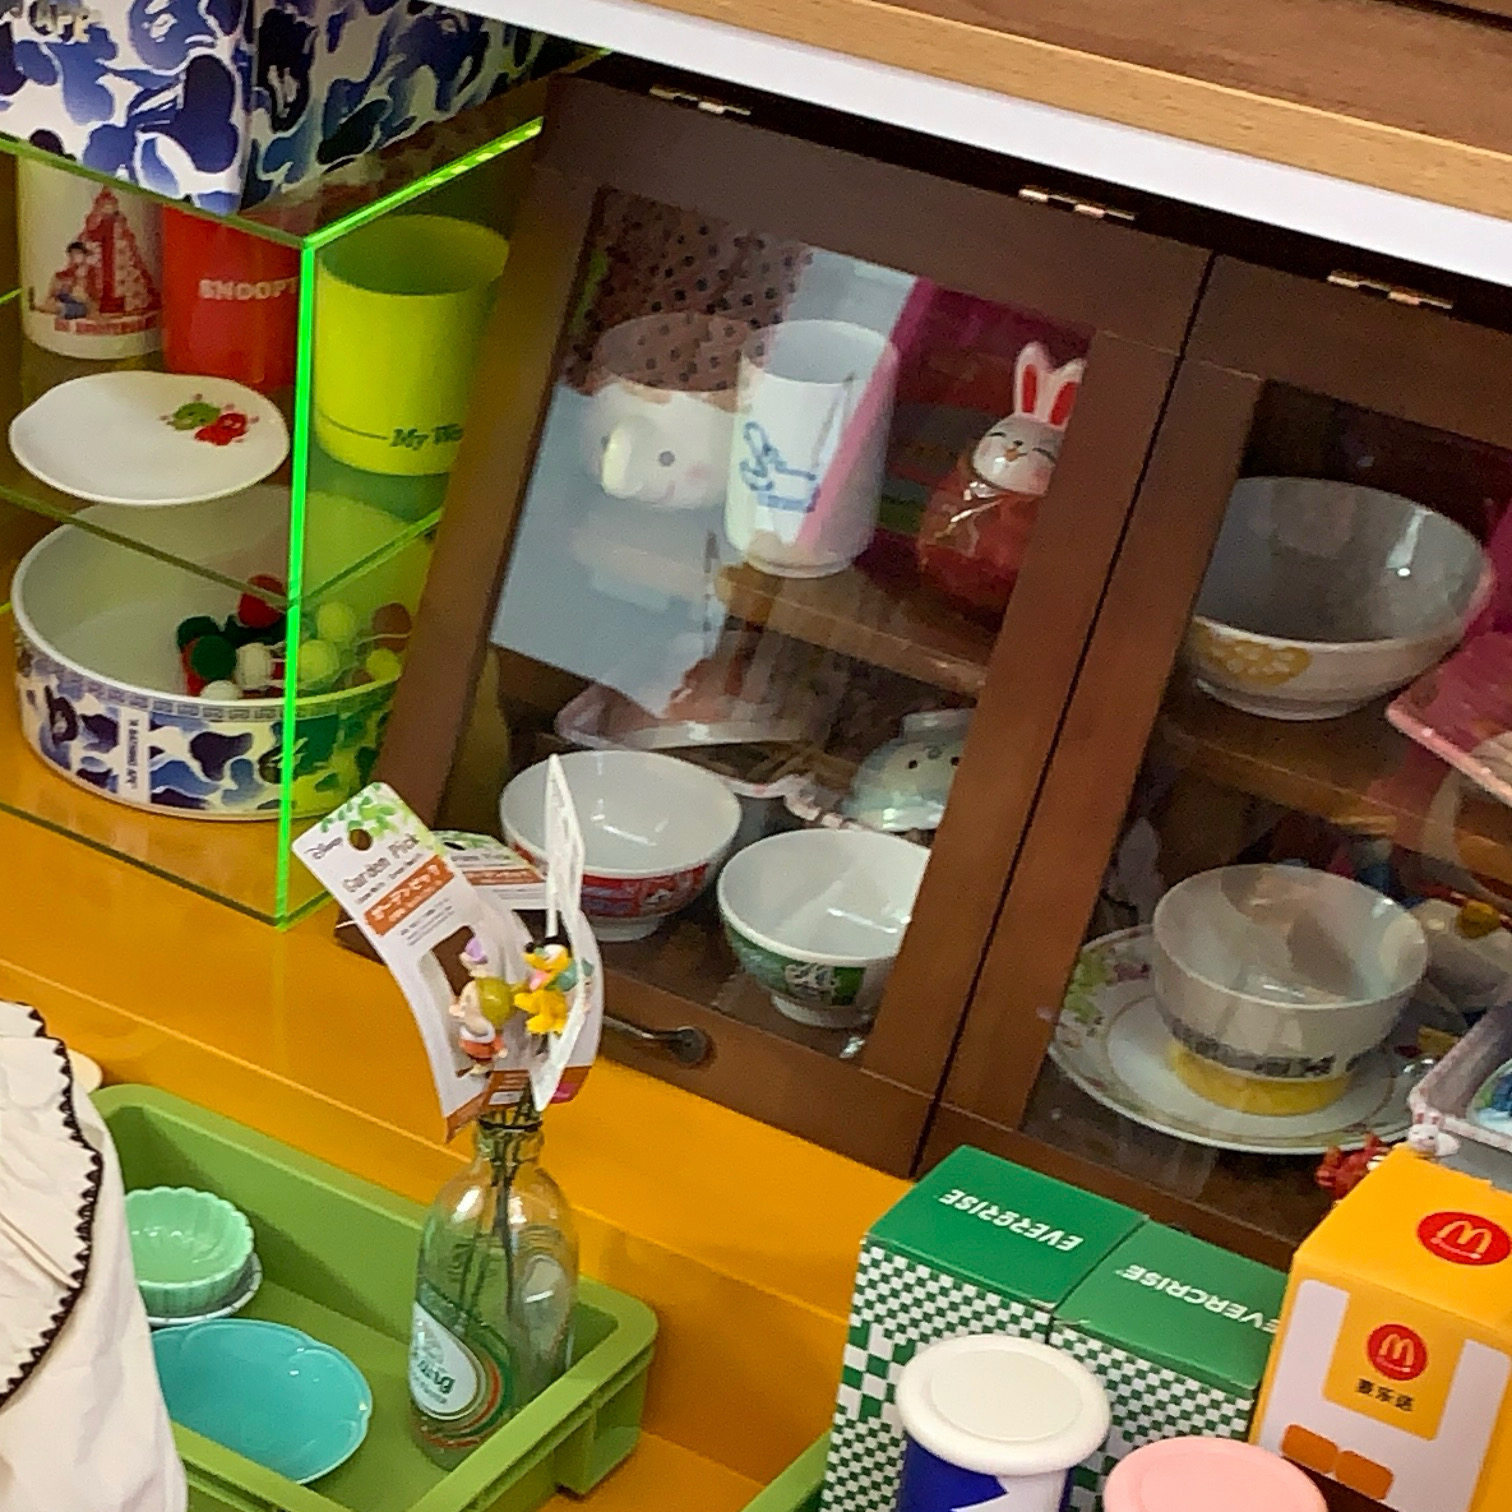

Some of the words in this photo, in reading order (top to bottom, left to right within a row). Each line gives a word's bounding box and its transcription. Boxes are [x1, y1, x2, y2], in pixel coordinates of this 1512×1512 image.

[390, 428, 429, 450] My
[342, 857, 391, 893] Garden
[388, 833, 420, 859] Pick
